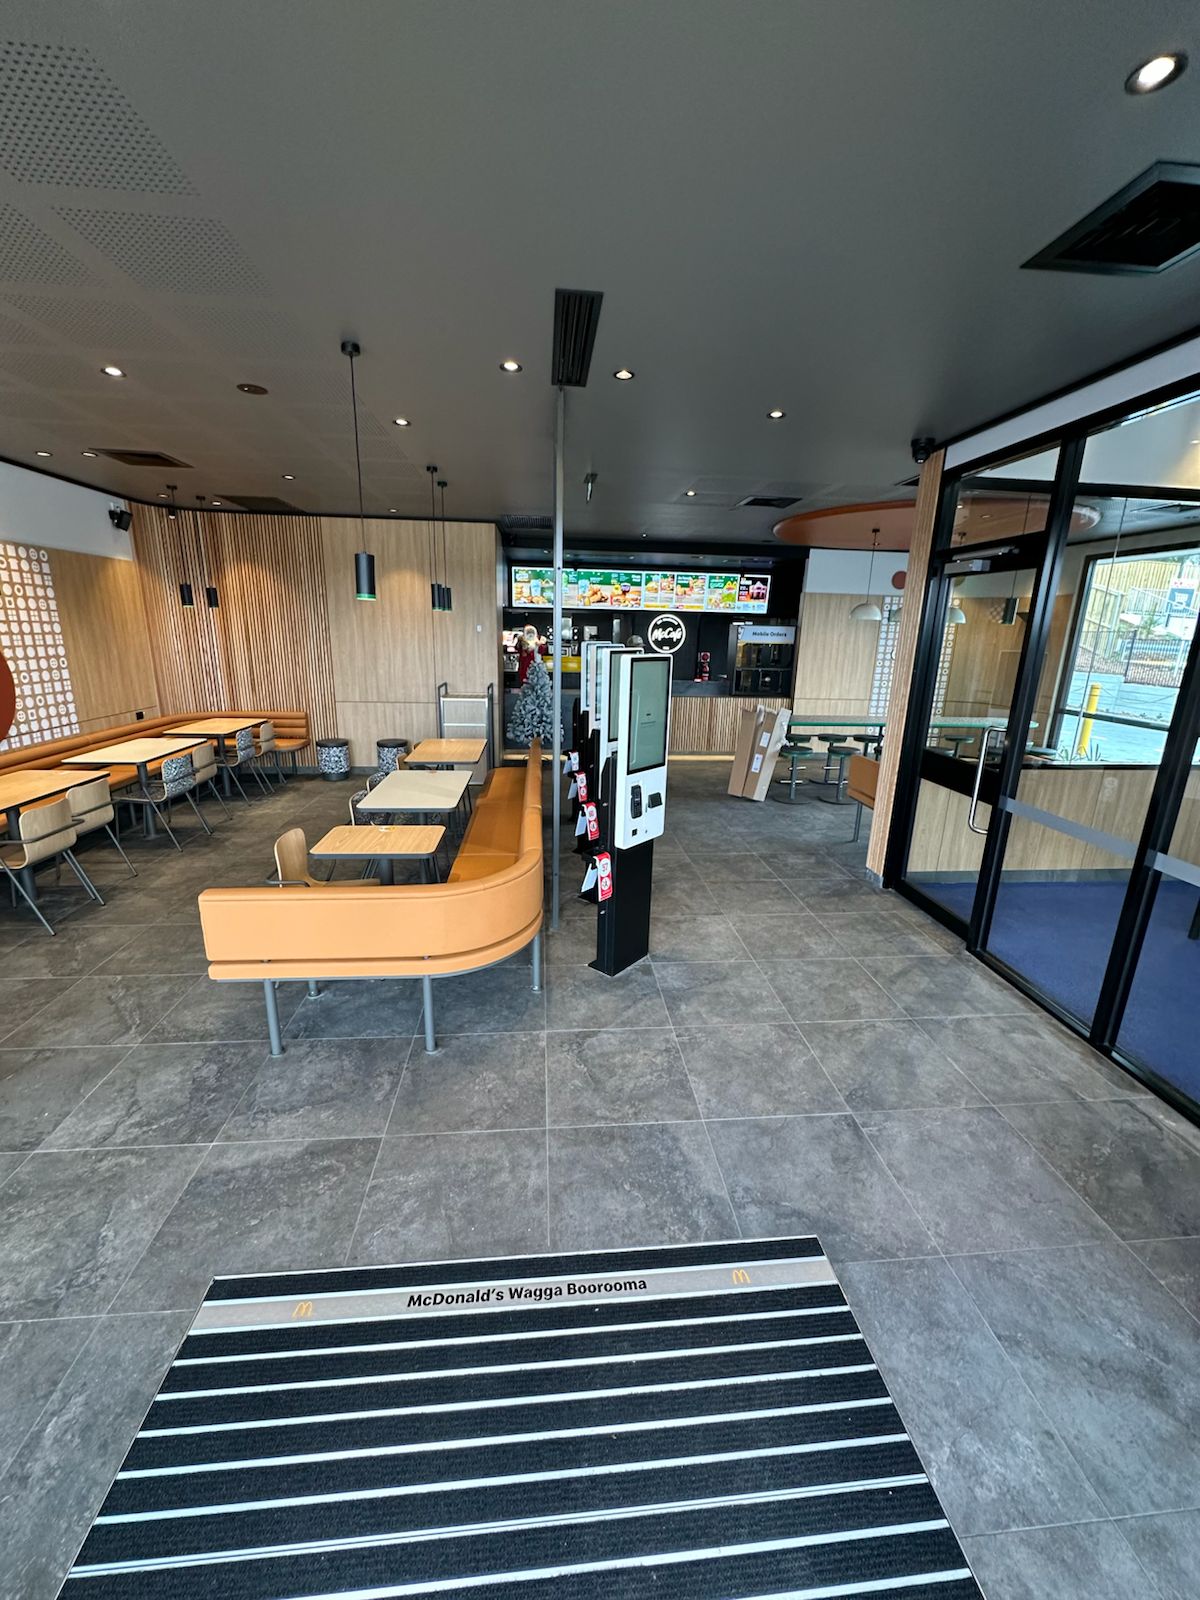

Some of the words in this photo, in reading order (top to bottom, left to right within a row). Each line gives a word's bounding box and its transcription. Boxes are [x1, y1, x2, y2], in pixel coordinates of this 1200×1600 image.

[407, 1287, 504, 1308] McDonald's
[509, 1285, 563, 1301] Wagga
[567, 1280, 647, 1295] Boorooma
